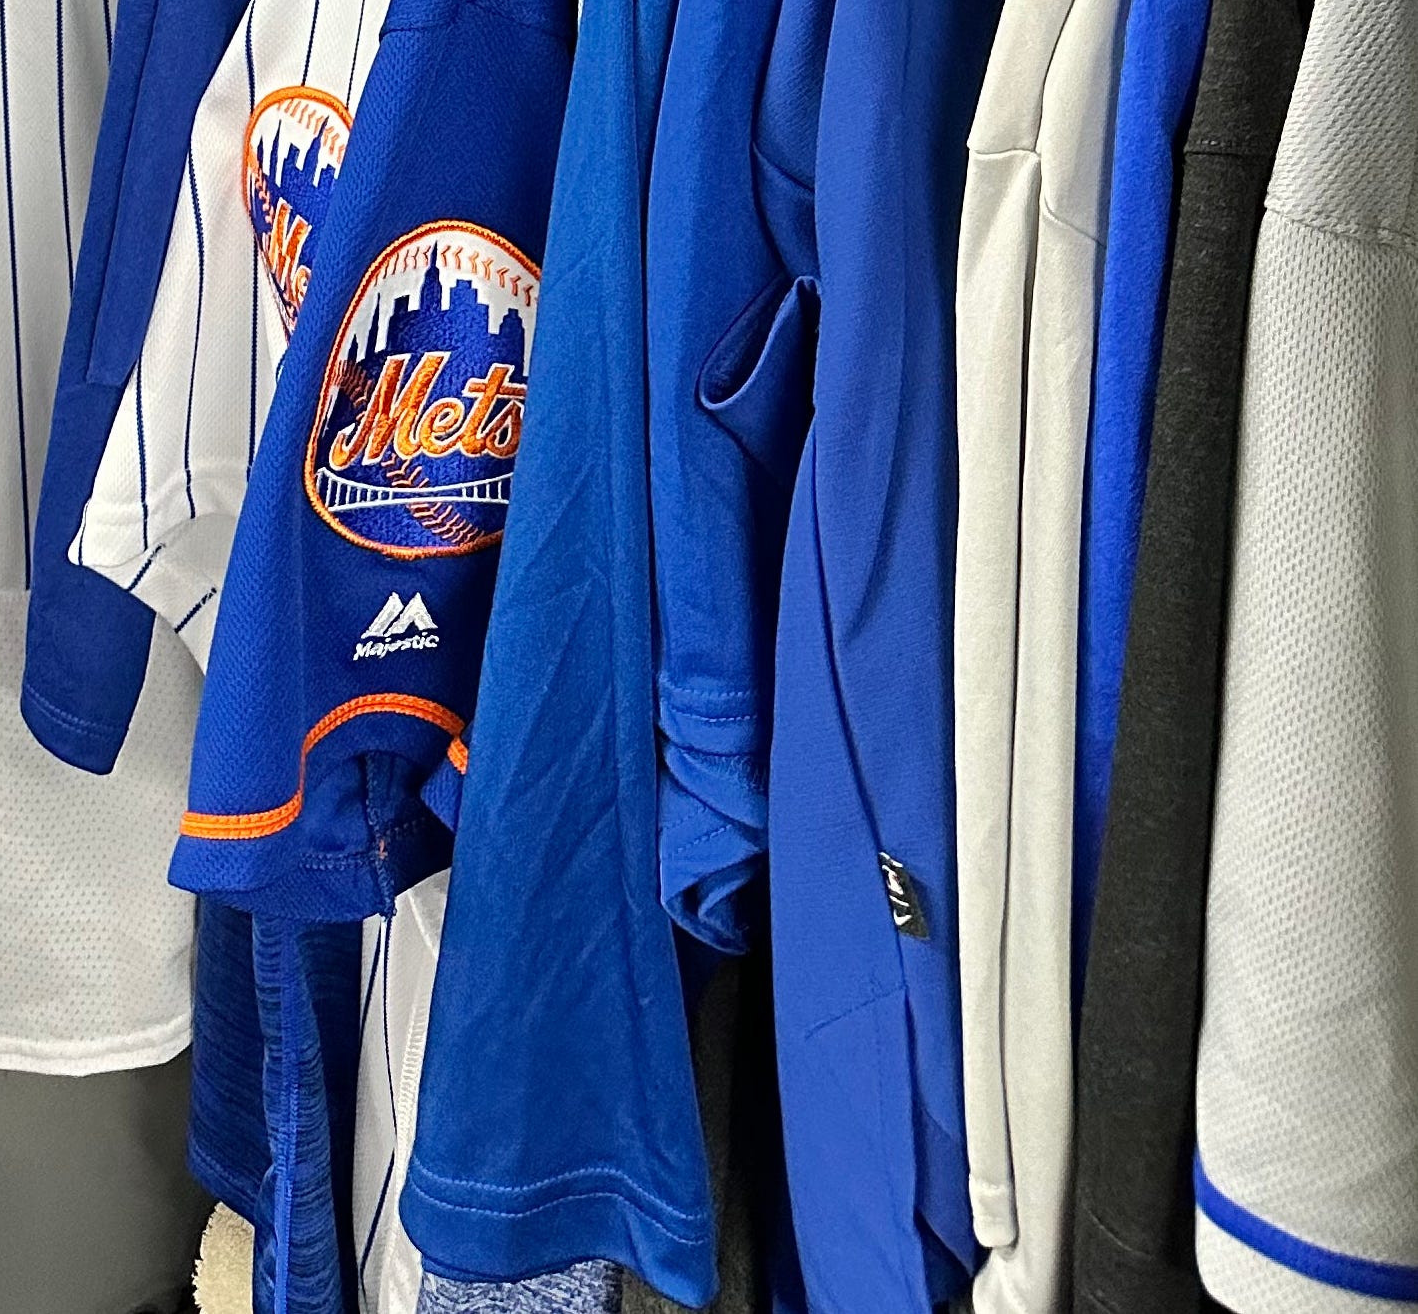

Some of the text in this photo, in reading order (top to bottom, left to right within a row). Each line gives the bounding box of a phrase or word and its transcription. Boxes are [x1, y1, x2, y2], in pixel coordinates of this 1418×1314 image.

[265, 197, 312, 313] Me
[328, 351, 528, 471] Mets
[352, 631, 440, 662] Majestic
